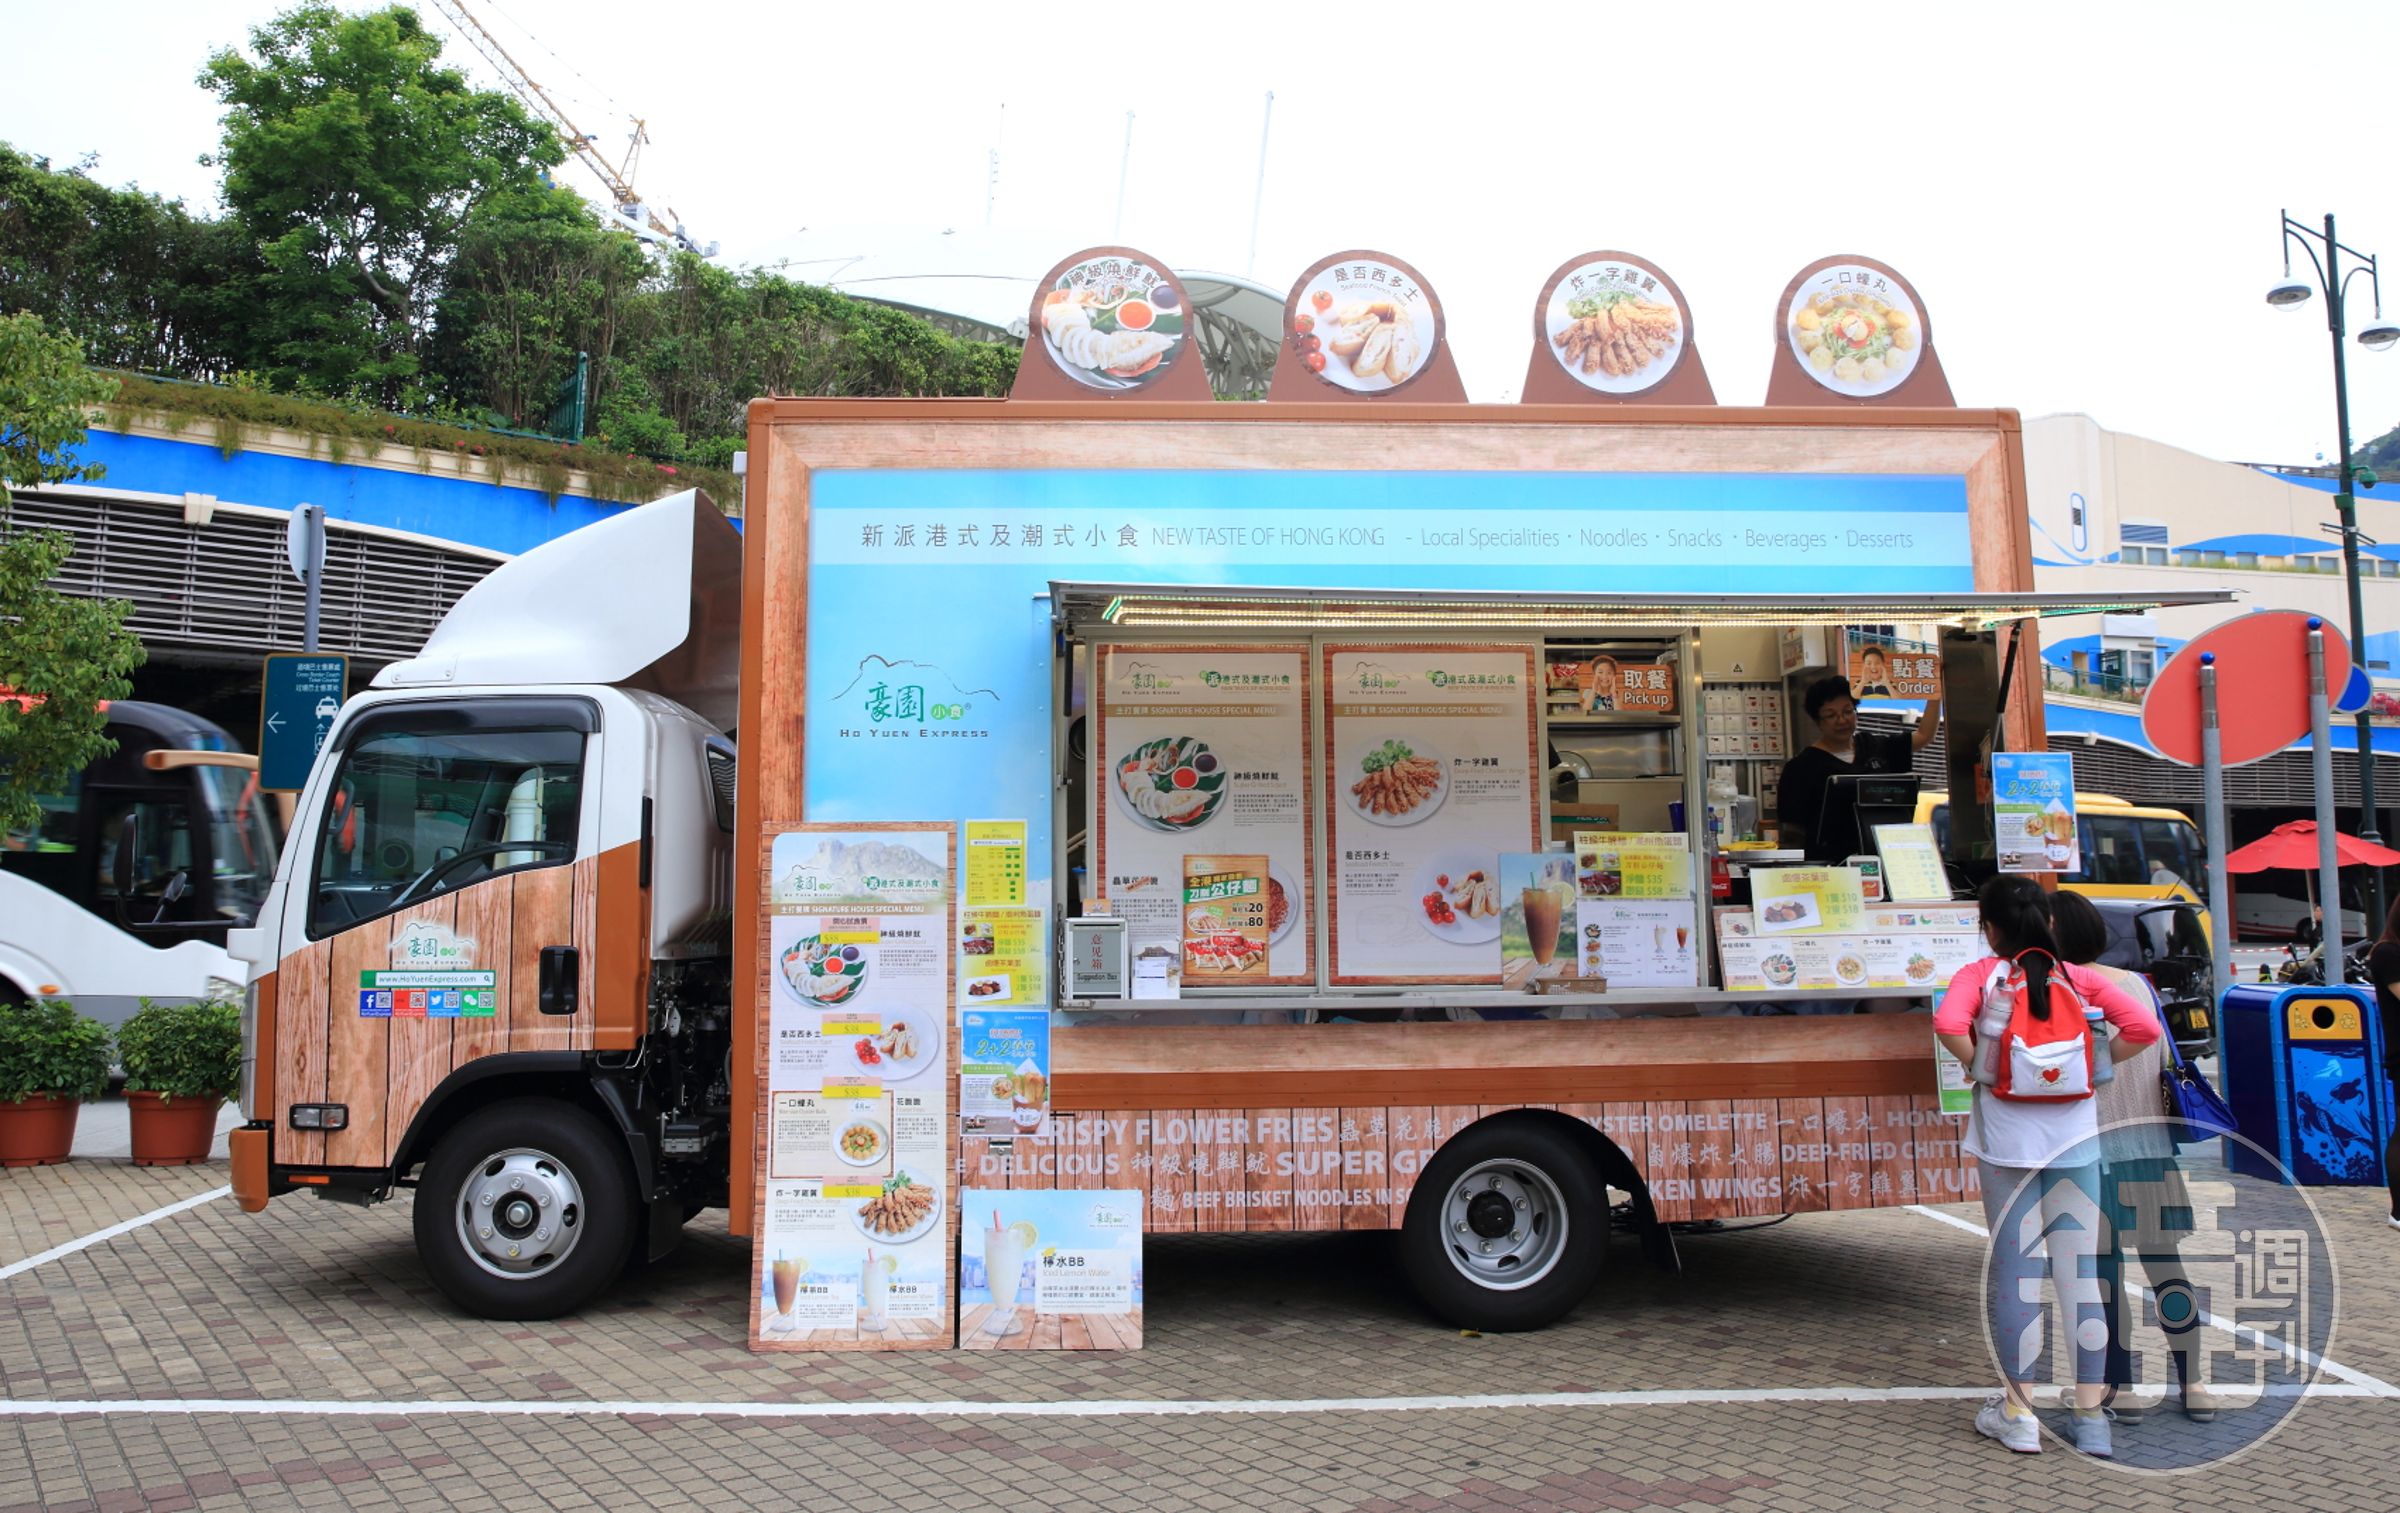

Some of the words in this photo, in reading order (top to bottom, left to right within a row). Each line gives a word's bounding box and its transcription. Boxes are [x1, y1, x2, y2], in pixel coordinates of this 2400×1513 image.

[1334, 266, 1418, 302] 是否西多士
[1571, 267, 1657, 293] 炸一字雞翼
[1821, 271, 1887, 293] 一口蠔丸
[861, 523, 1139, 548] 新派港式及潮式小食
[1152, 527, 1192, 546] NEW
[1198, 527, 1246, 546] TASTE
[1252, 527, 1274, 546] OF
[1281, 527, 1333, 546] HONG
[1339, 527, 1384, 546] KONG
[1421, 528, 1464, 547] Local
[1469, 528, 1559, 551] Specialities
[1580, 528, 1648, 547] Noodles
[1668, 528, 1722, 547] Snacks
[1745, 529, 1827, 552] Beverages
[1846, 529, 1914, 548] Desserts
[1892, 658, 1935, 678] 點餐
[1623, 669, 1667, 690] 取餐
[1898, 681, 1936, 694] Order
[1379, 706, 1420, 714] SIGNATURE
[1421, 706, 1447, 714] HOUSE
[1448, 706, 1479, 714] SPECIAL
[1480, 706, 1503, 714] MENU
[1624, 692, 1649, 705] Pick
[1652, 695, 1669, 707] up
[1151, 706, 1194, 715] SIGNATURE
[1195, 706, 1221, 715] HOUSE
[1222, 706, 1251, 715] SPECIAL
[1253, 706, 1276, 715] MENU
[379, 975, 477, 985] www.HoYuenExpress.com
[1077, 973, 1105, 982] Suggestion
[1107, 973, 1117, 981] Box
[1136, 1117, 1249, 1145] FLOWER
[1257, 1116, 1333, 1143] FRIES
[1580, 1116, 1653, 1133] YSTER
[1659, 1113, 1767, 1131] OMELETTE
[980, 1154, 1121, 1176] DELICIOUS
[1276, 1149, 1386, 1176] SUPER
[1782, 1141, 1897, 1163] DEEP-FRIED
[1700, 1176, 1781, 1199] WINGS
[1183, 1190, 1221, 1209] BEEF
[1225, 1189, 1290, 1208] BRISKET
[1294, 1188, 1372, 1207] NOODLES
[1375, 1188, 1392, 1205] IN
[1042, 1255, 1085, 1268] 檸水BB
